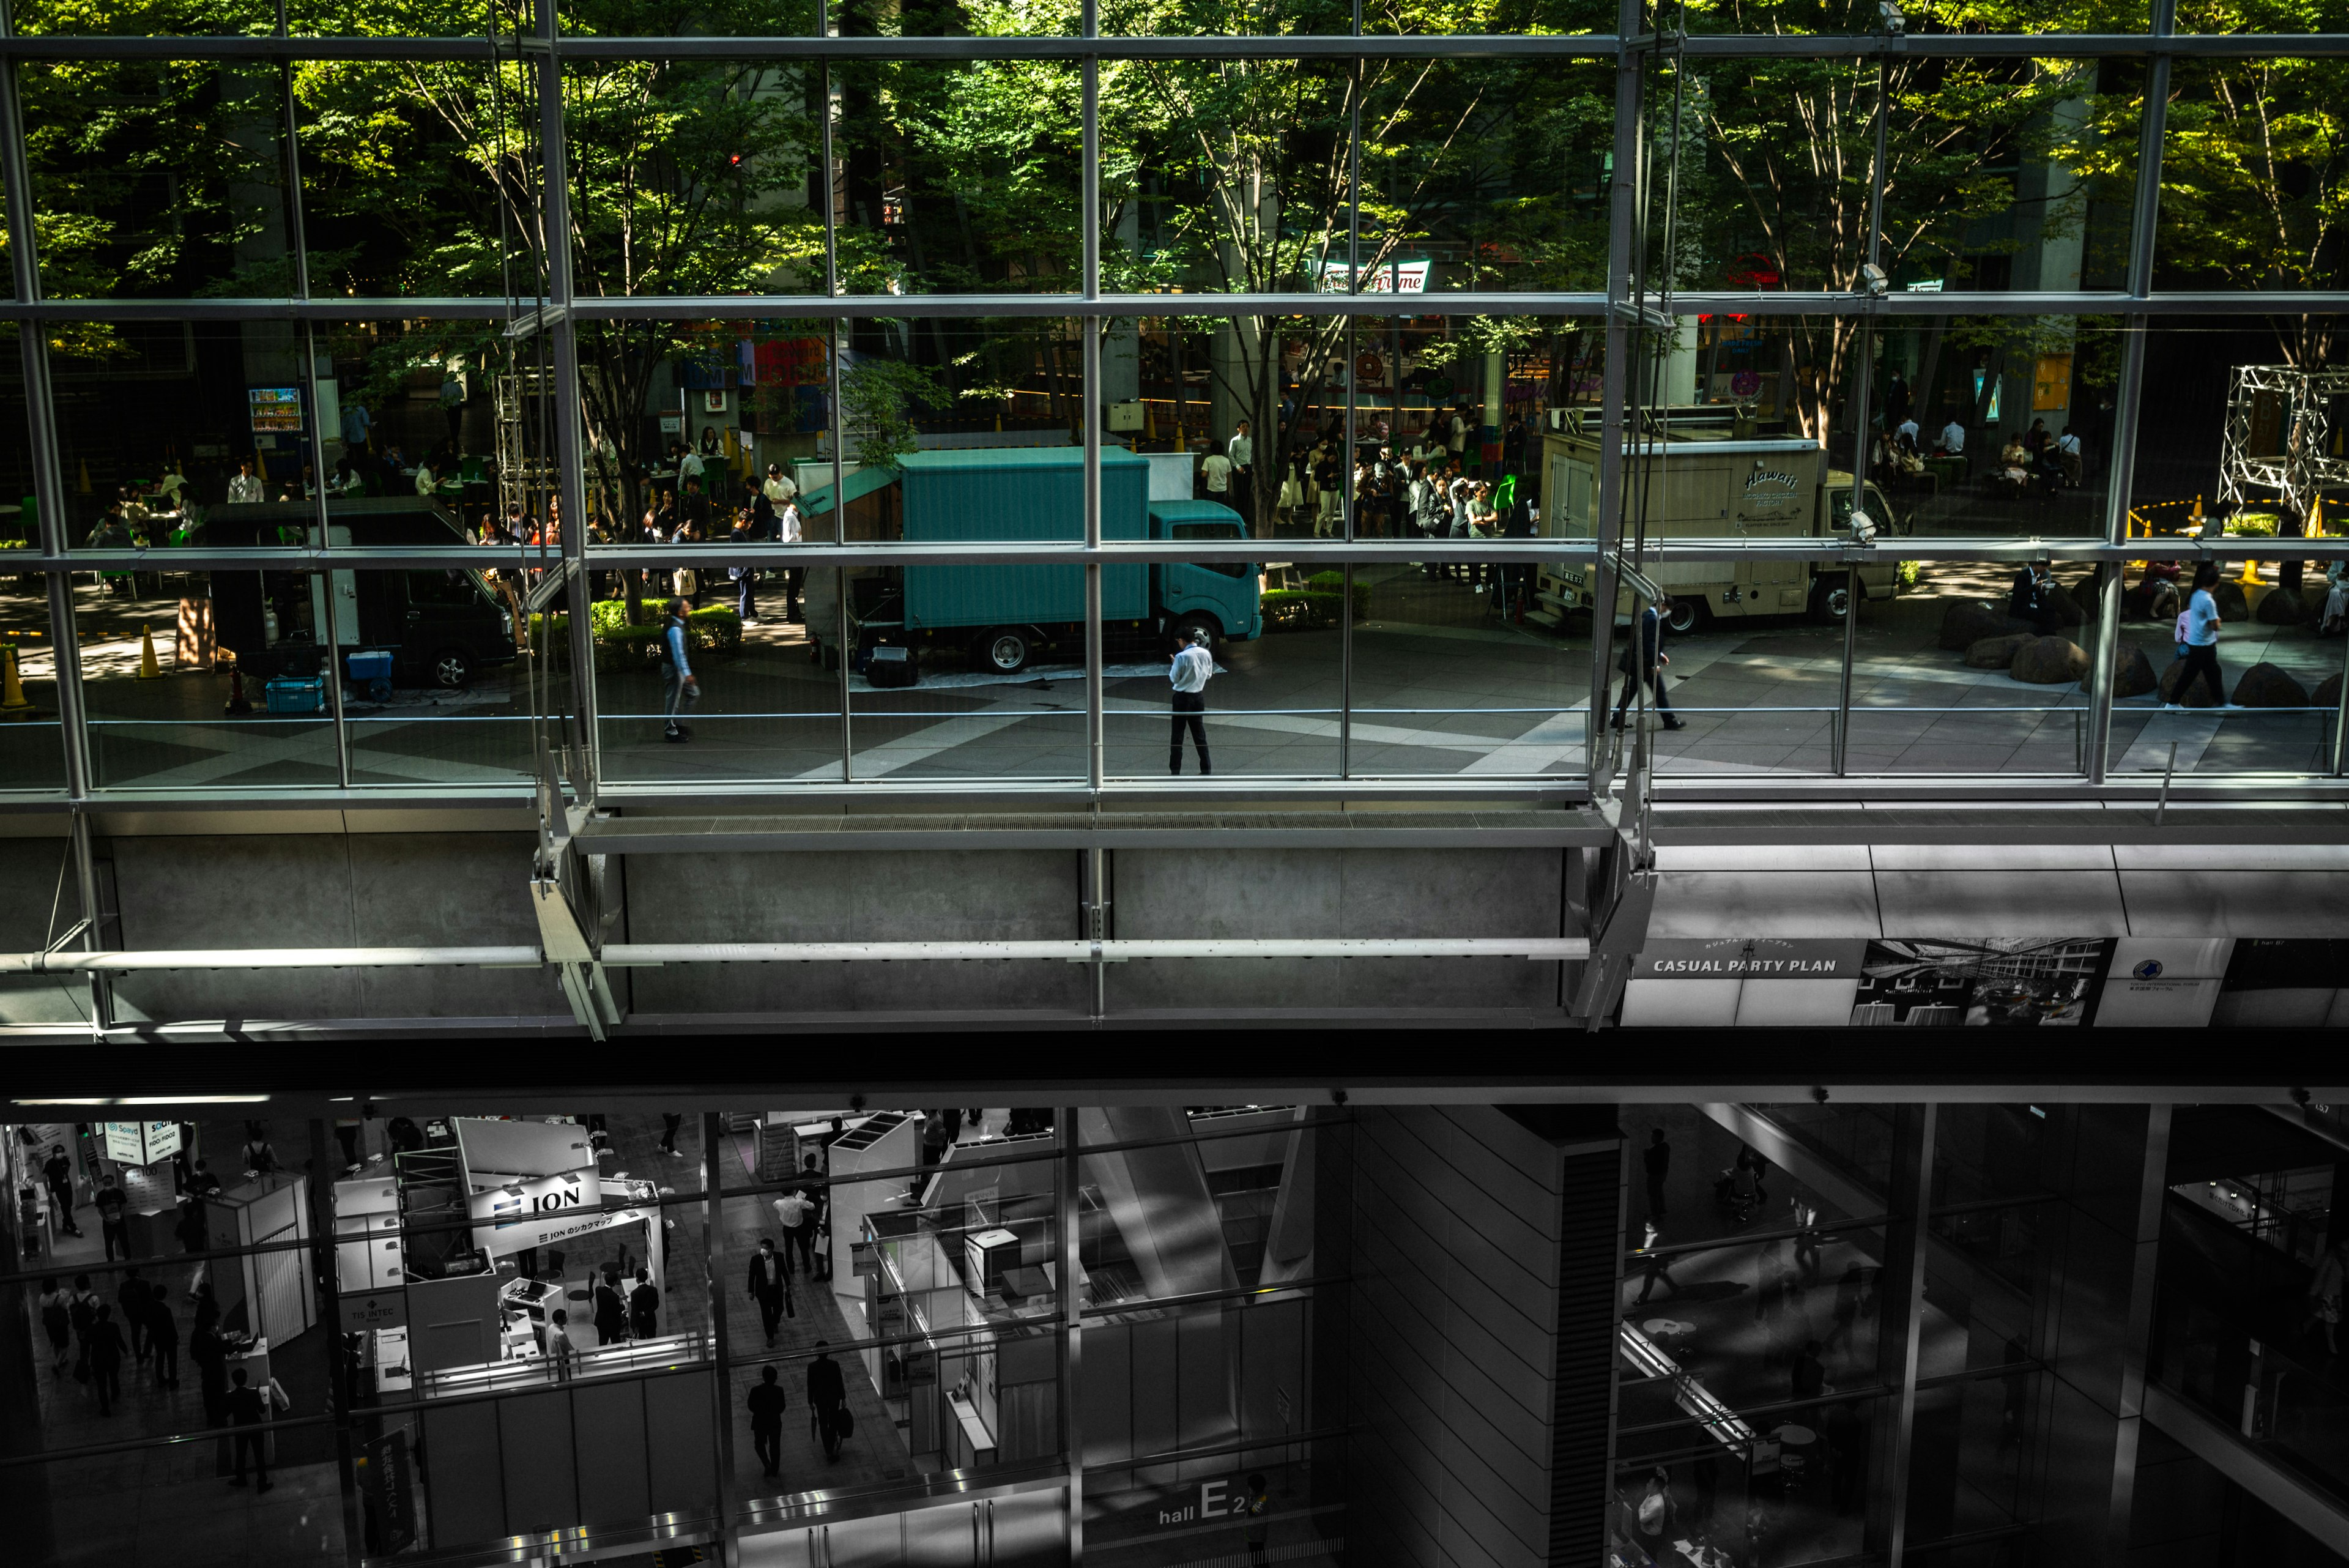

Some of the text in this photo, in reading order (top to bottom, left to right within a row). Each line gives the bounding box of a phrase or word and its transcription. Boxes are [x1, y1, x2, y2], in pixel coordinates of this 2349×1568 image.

[2260, 396, 2271, 420] B
[1745, 470, 1798, 491] Hawaii
[1564, 572, 1583, 585] 高圧ガス
[1653, 960, 1837, 972] CASUAL PARTY PLAN
[119, 1124, 138, 1135] Spayd
[141, 1167, 157, 1177] 100
[550, 1217, 613, 1240] JON のシカクマップ
[368, 1308, 393, 1317] INTEC
[1159, 1506, 1193, 1525] hall
